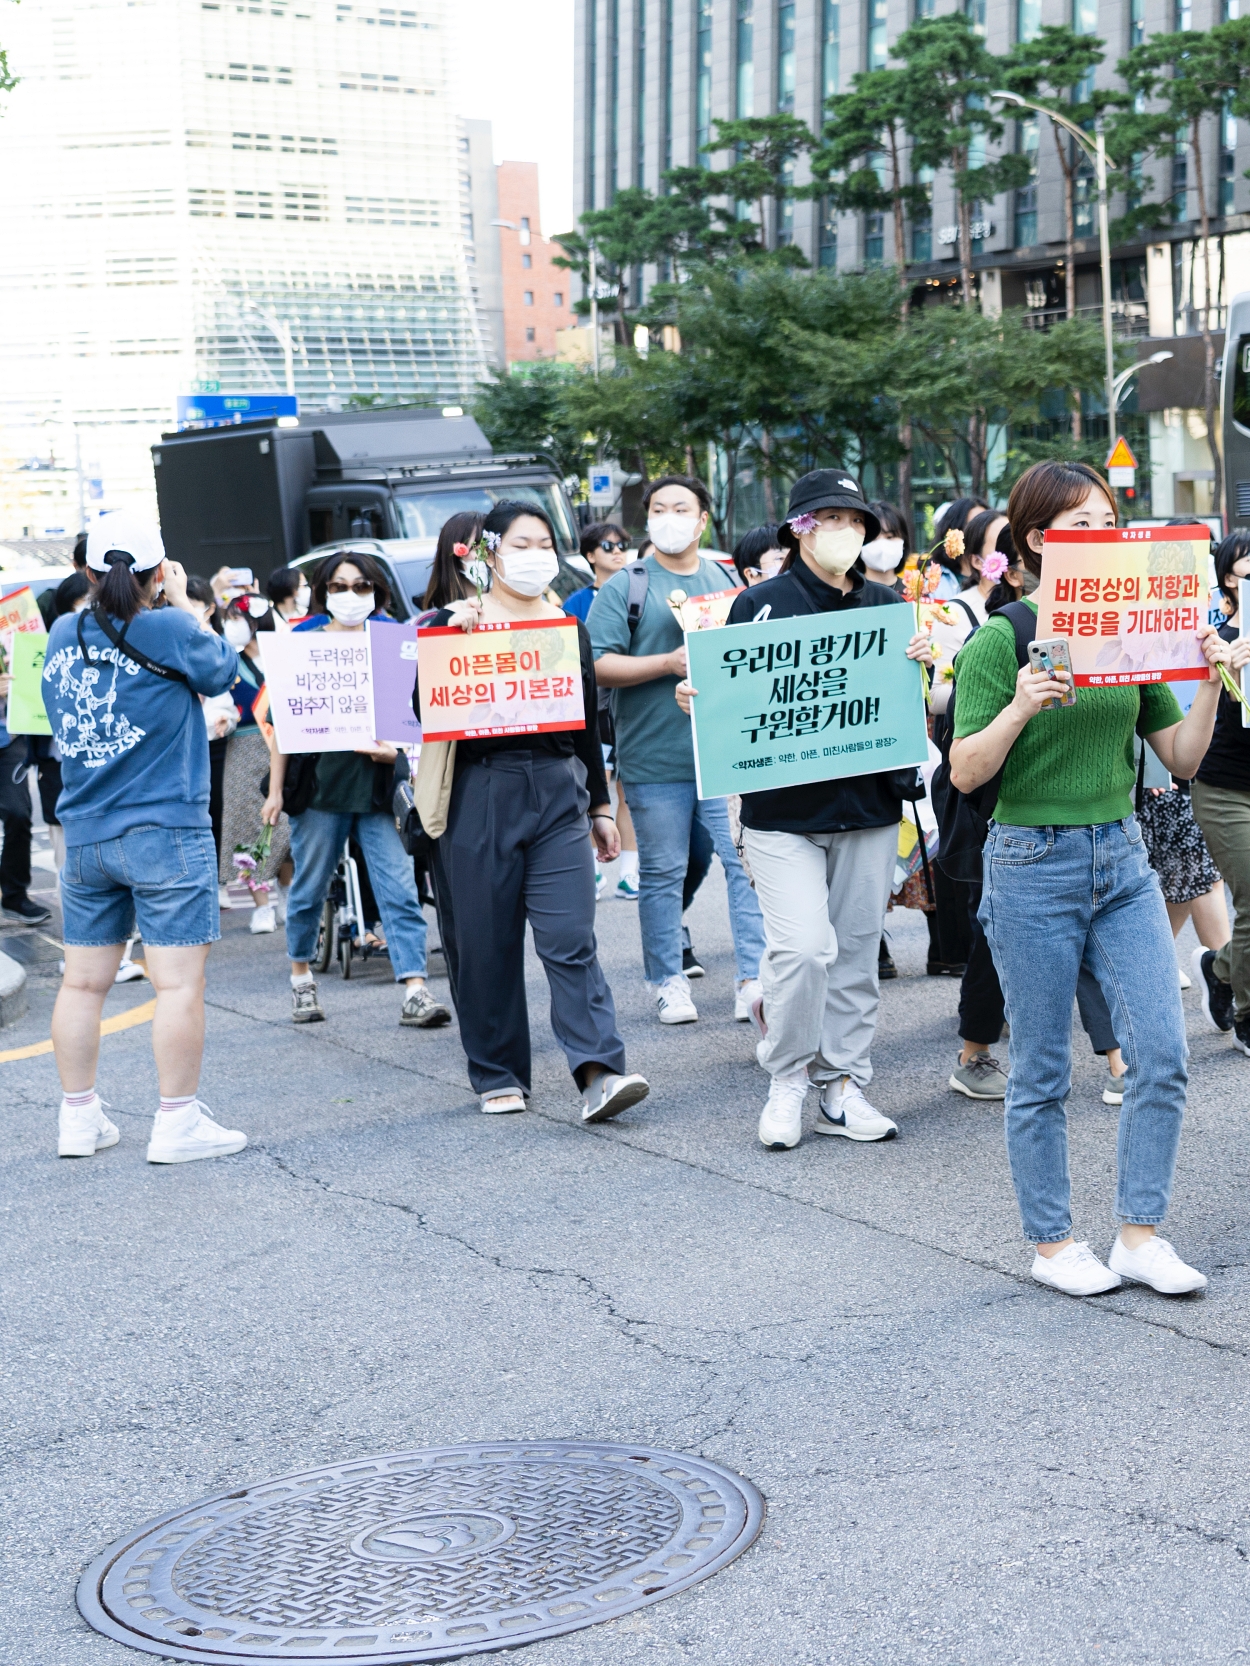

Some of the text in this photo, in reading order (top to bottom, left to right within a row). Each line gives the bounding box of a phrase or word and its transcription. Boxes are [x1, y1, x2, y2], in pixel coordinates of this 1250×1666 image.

[1055, 574, 1200, 602] 비정상의 저항과
[1052, 607, 1200, 637] 혁명을 기대하라
[100, 646, 141, 676] CLUB
[449, 650, 541, 677] 아픈몸이
[721, 639, 802, 678] 우리의
[809, 628, 888, 667] 광기가
[296, 672, 357, 691] 비정상의
[429, 676, 574, 708] 세상의 기본값
[768, 667, 848, 705] 세상을
[288, 696, 368, 715] 멈추지 않을
[741, 697, 881, 744] 구원할거야!
[108, 726, 146, 757] FISH
[875, 737, 898, 749] 광장>
